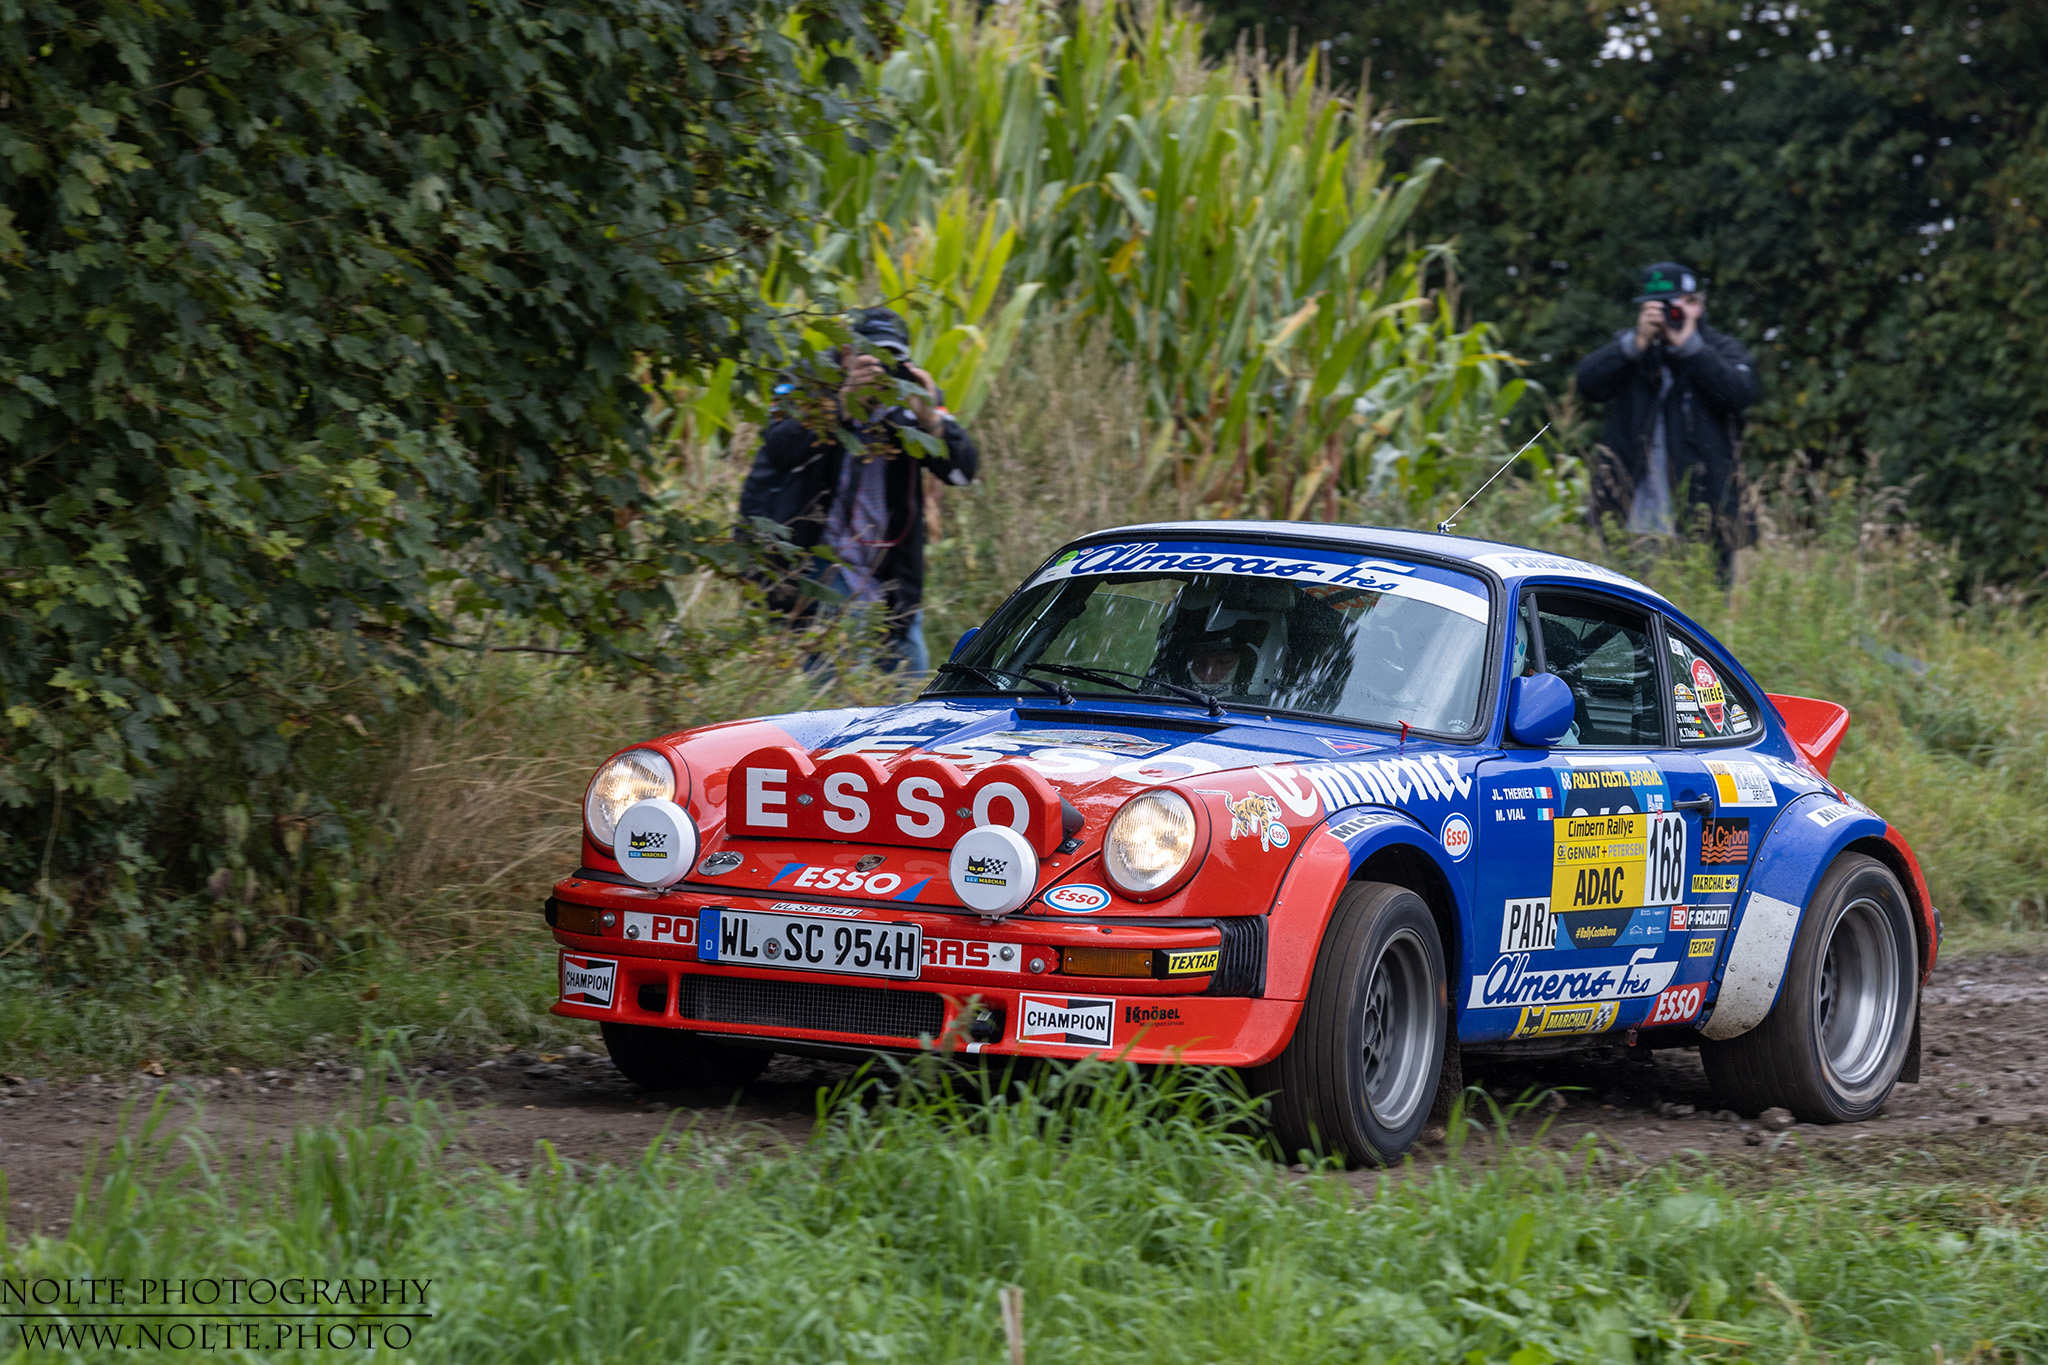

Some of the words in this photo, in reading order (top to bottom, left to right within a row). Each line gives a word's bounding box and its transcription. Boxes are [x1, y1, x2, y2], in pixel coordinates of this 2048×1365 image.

[1697, 686, 1724, 704] THIELE
[1560, 772, 1572, 790] 68
[1572, 771, 1600, 789] RALLY
[1600, 771, 1630, 788] COSTA
[1630, 770, 1663, 786] BRAVA
[746, 767, 1030, 838] ESSO
[1503, 787, 1535, 800] THERIER
[1495, 810, 1506, 822] M.
[1506, 808, 1526, 821] VIAL
[1568, 820, 1605, 838] Cimbern
[1606, 818, 1634, 838] Rallye
[1702, 825, 1714, 848] de
[1716, 825, 1749, 848] Carbon
[641, 851, 667, 859] MARCHAL
[1567, 845, 1601, 861] GENNAT
[1608, 842, 1645, 858] PETERSEN
[1649, 817, 1683, 902] 168
[793, 866, 902, 894] ESSO
[978, 877, 1006, 886] MARCHAL
[1573, 865, 1625, 907] ADAC
[1693, 875, 1724, 891] MARCHAL
[721, 916, 759, 958] WL
[784, 923, 824, 963] SC
[834, 926, 916, 971] 954H
[1688, 939, 1715, 955] TEXTAR
[1170, 952, 1218, 971] TEXTAR
[565, 969, 610, 992] CHAMPION
[1482, 952, 1617, 1006] Almeras
[1653, 986, 1700, 1022] ESSO
[1027, 1010, 1106, 1032] CHAMPION
[1546, 1012, 1592, 1030] MARCHAL
